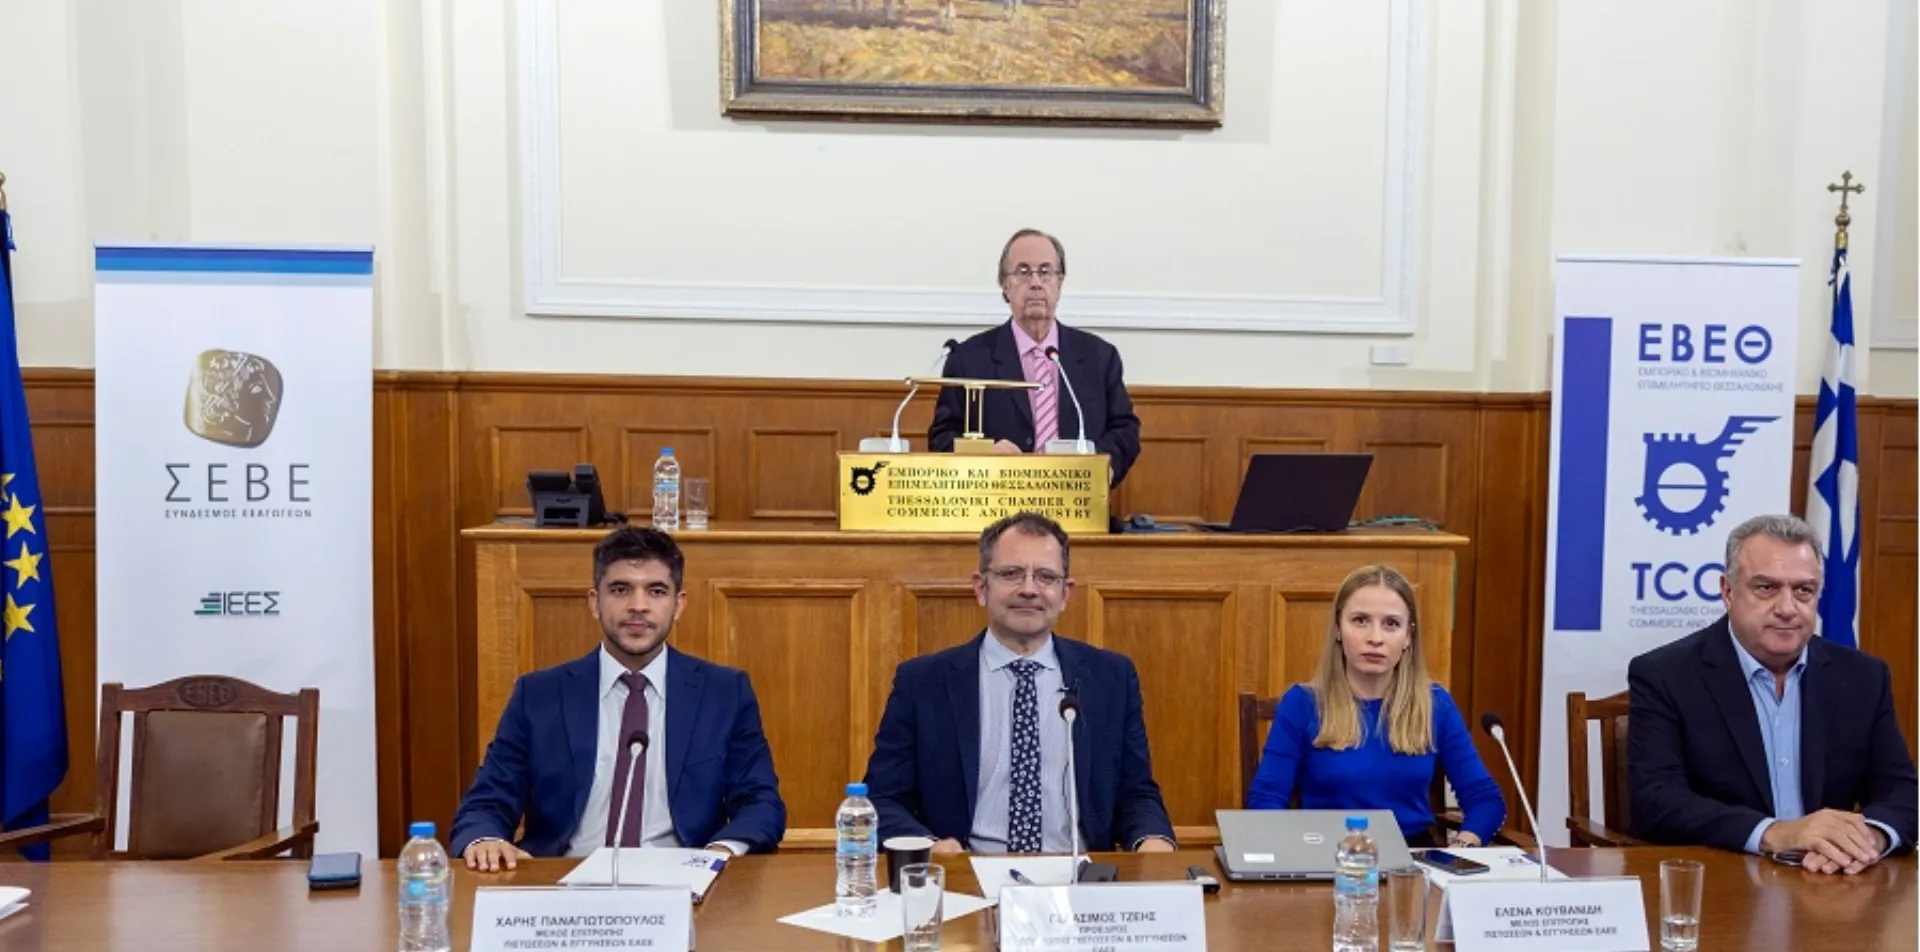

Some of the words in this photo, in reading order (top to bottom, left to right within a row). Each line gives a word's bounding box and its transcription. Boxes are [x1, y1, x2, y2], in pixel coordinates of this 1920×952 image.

[1638, 323, 1773, 364] ΕΒΕΘ
[888, 467, 959, 477] ΕΜΠΟΡΙΚΟ
[968, 469, 989, 478] ΚΑΙ
[1000, 469, 1091, 478] ΒΙΟΜΗΧΑΝΙΚΟ
[165, 463, 311, 502] ΣΕΒΕ
[888, 480, 989, 489] ΕΠΙΜΕΛΗΤΗΡΙΟ
[991, 480, 1092, 491] ΘΕΣΣΑΛΟΝΙΚΗΣ
[888, 495, 989, 506] THESSALONIKI
[998, 497, 1065, 506] CHAMBER
[1073, 497, 1091, 506] OF
[165, 509, 237, 519] ΣΥΝΔΕΣΜΟΣ
[887, 507, 969, 517] COMMERCE
[979, 508, 1008, 517] AND
[1495, 906, 1533, 917] ΕΛΕΝΑ
[1535, 904, 1602, 916] ΚΟΥΒΑΝΙΔΗ
[495, 916, 537, 927] ΧΑΡΗΣ
[541, 914, 666, 926] ΠΑΝΑΓΙΩΤΟΠΟΥΛΟΣ
[1120, 911, 1157, 922] ΤΖΕΗΣ
[1510, 919, 1540, 927] ΜΕΛΟΣ
[535, 929, 568, 937] ΜΕΛΟΣ
[571, 928, 624, 937] ΕΠΙΤΡΟΠΗΣ
[1535, 928, 1541, 937] &
[560, 940, 568, 949] &
